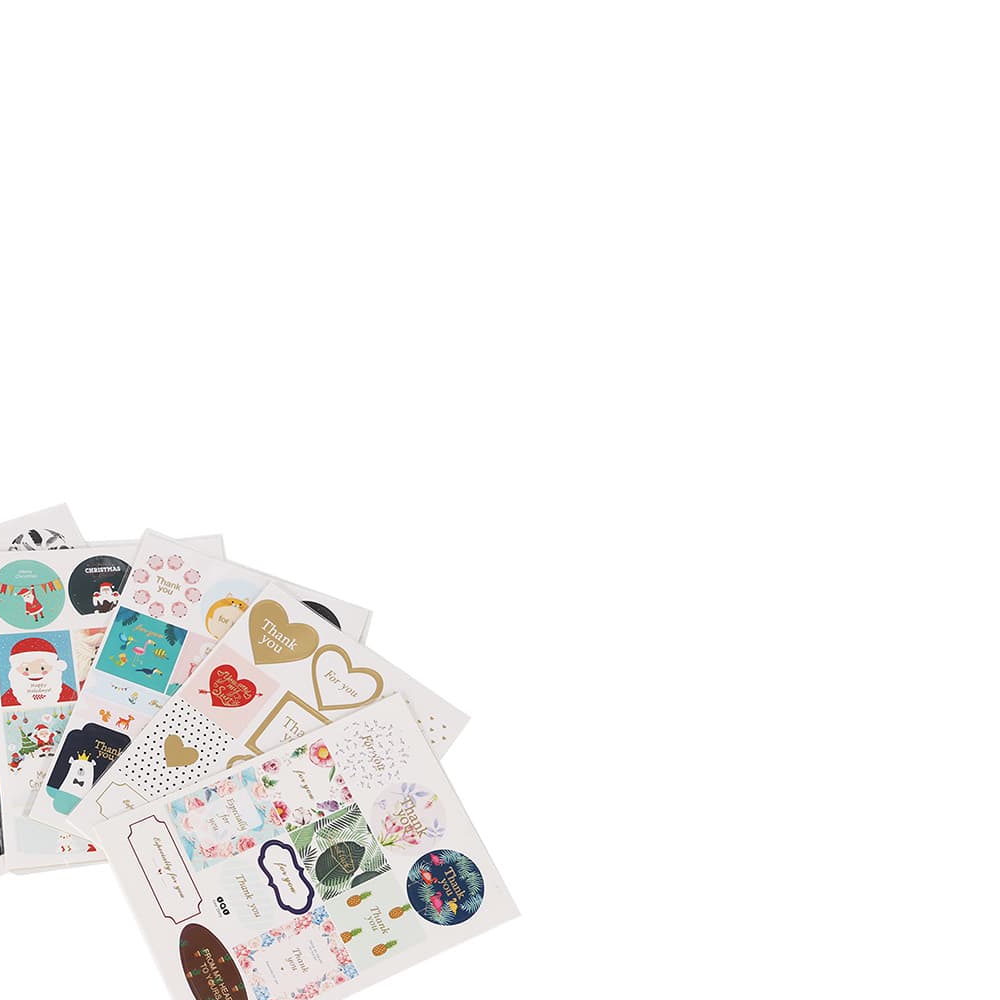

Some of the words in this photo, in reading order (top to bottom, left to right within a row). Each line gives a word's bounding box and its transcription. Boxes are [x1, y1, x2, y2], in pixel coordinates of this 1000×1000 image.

[84, 565, 121, 575] CHRISTMAS
[156, 575, 182, 592] Thank
[156, 586, 174, 597] you
[217, 614, 230, 626] for
[258, 633, 282, 654] you
[262, 617, 299, 652] Thank
[323, 669, 340, 685] For
[340, 682, 359, 699] you
[281, 715, 306, 738] Tha
[226, 797, 249, 832] Especially
[393, 808, 413, 835] you
[400, 794, 430, 838] Thank
[235, 873, 256, 900] Thank
[247, 901, 262, 918] you
[437, 878, 454, 897] you
[443, 865, 466, 901] Thank
[364, 914, 378, 933] you
[370, 905, 391, 935] Thank
[202, 948, 217, 972] FROM
[292, 947, 311, 974] Thank
[200, 962, 209, 975] TO
[206, 974, 222, 1000] YOURS
